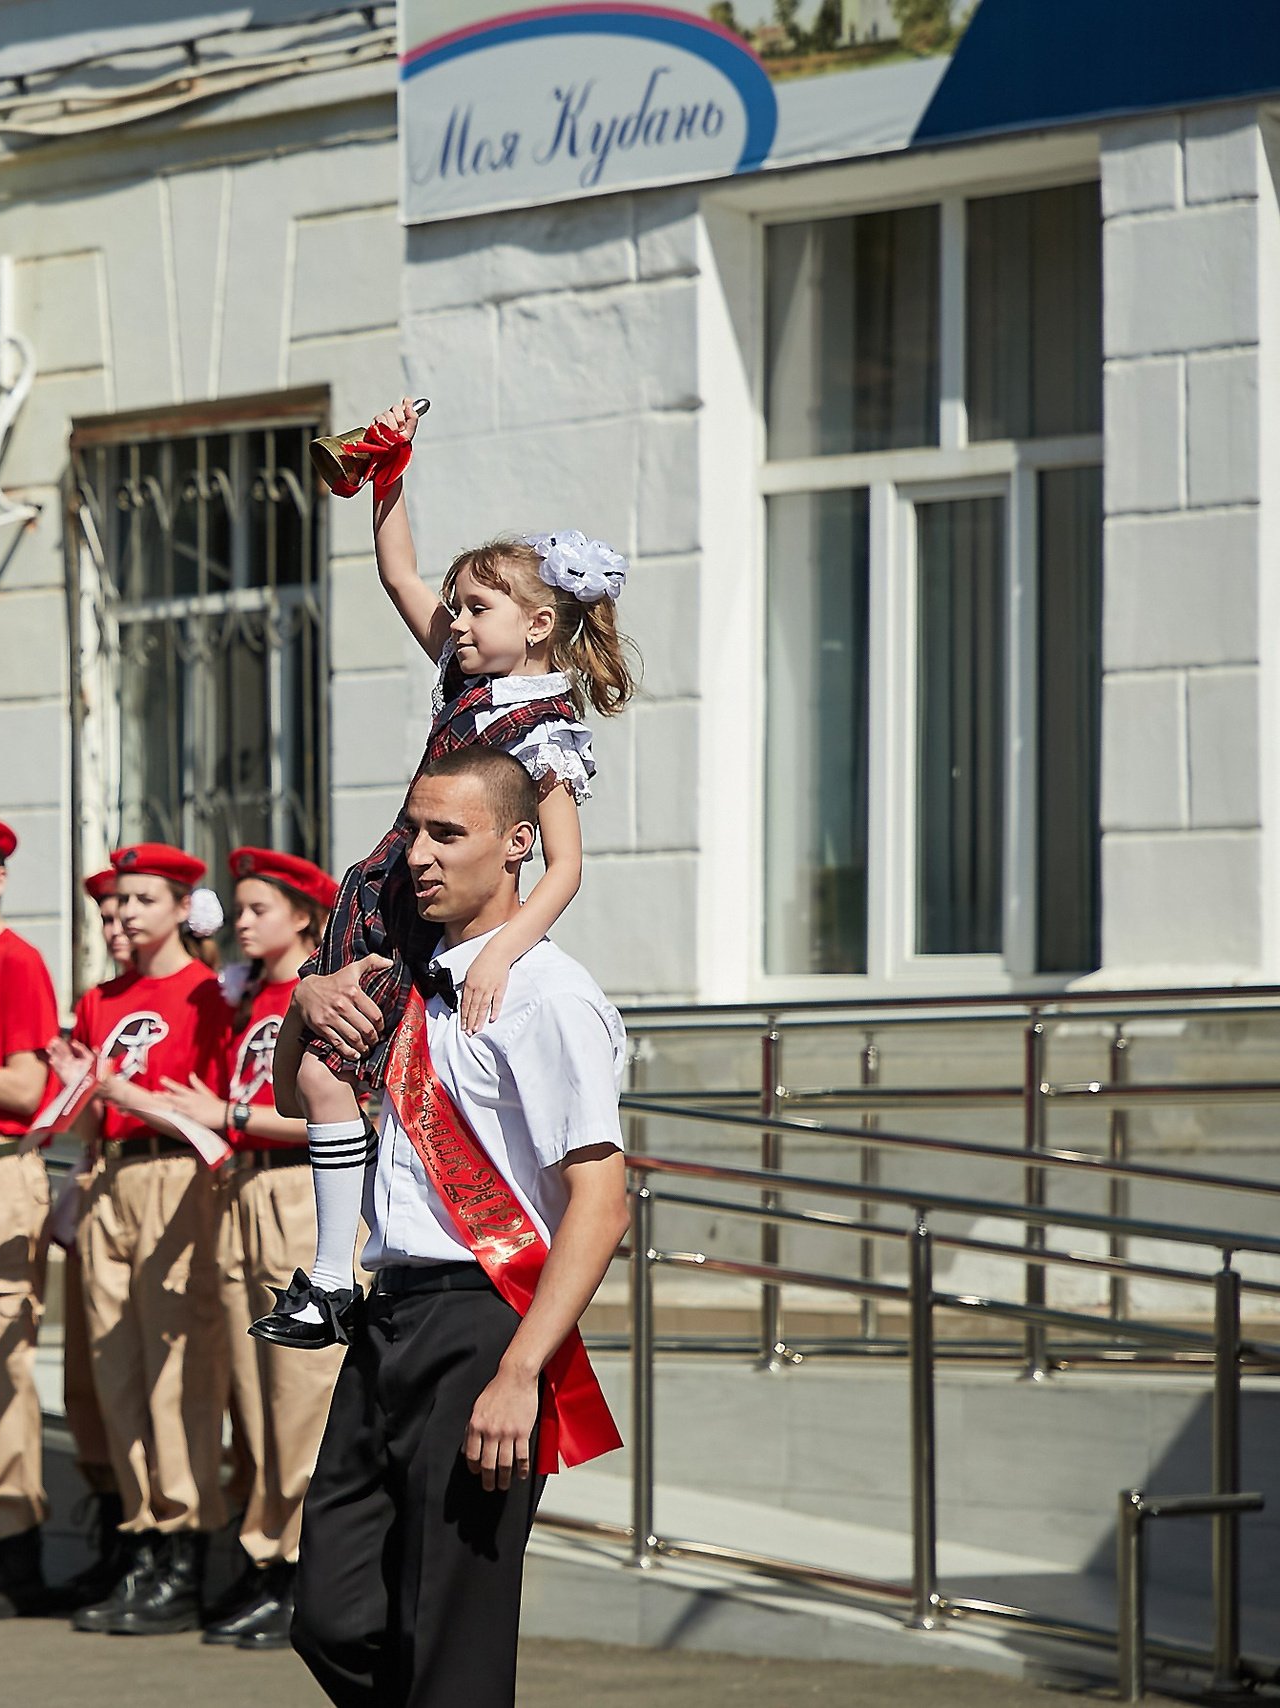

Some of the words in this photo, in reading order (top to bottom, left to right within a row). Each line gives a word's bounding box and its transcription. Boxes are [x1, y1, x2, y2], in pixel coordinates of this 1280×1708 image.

[411, 104, 520, 186] Моя
[532, 66, 724, 188] Кубань
[442, 1166, 538, 1265] 2024
